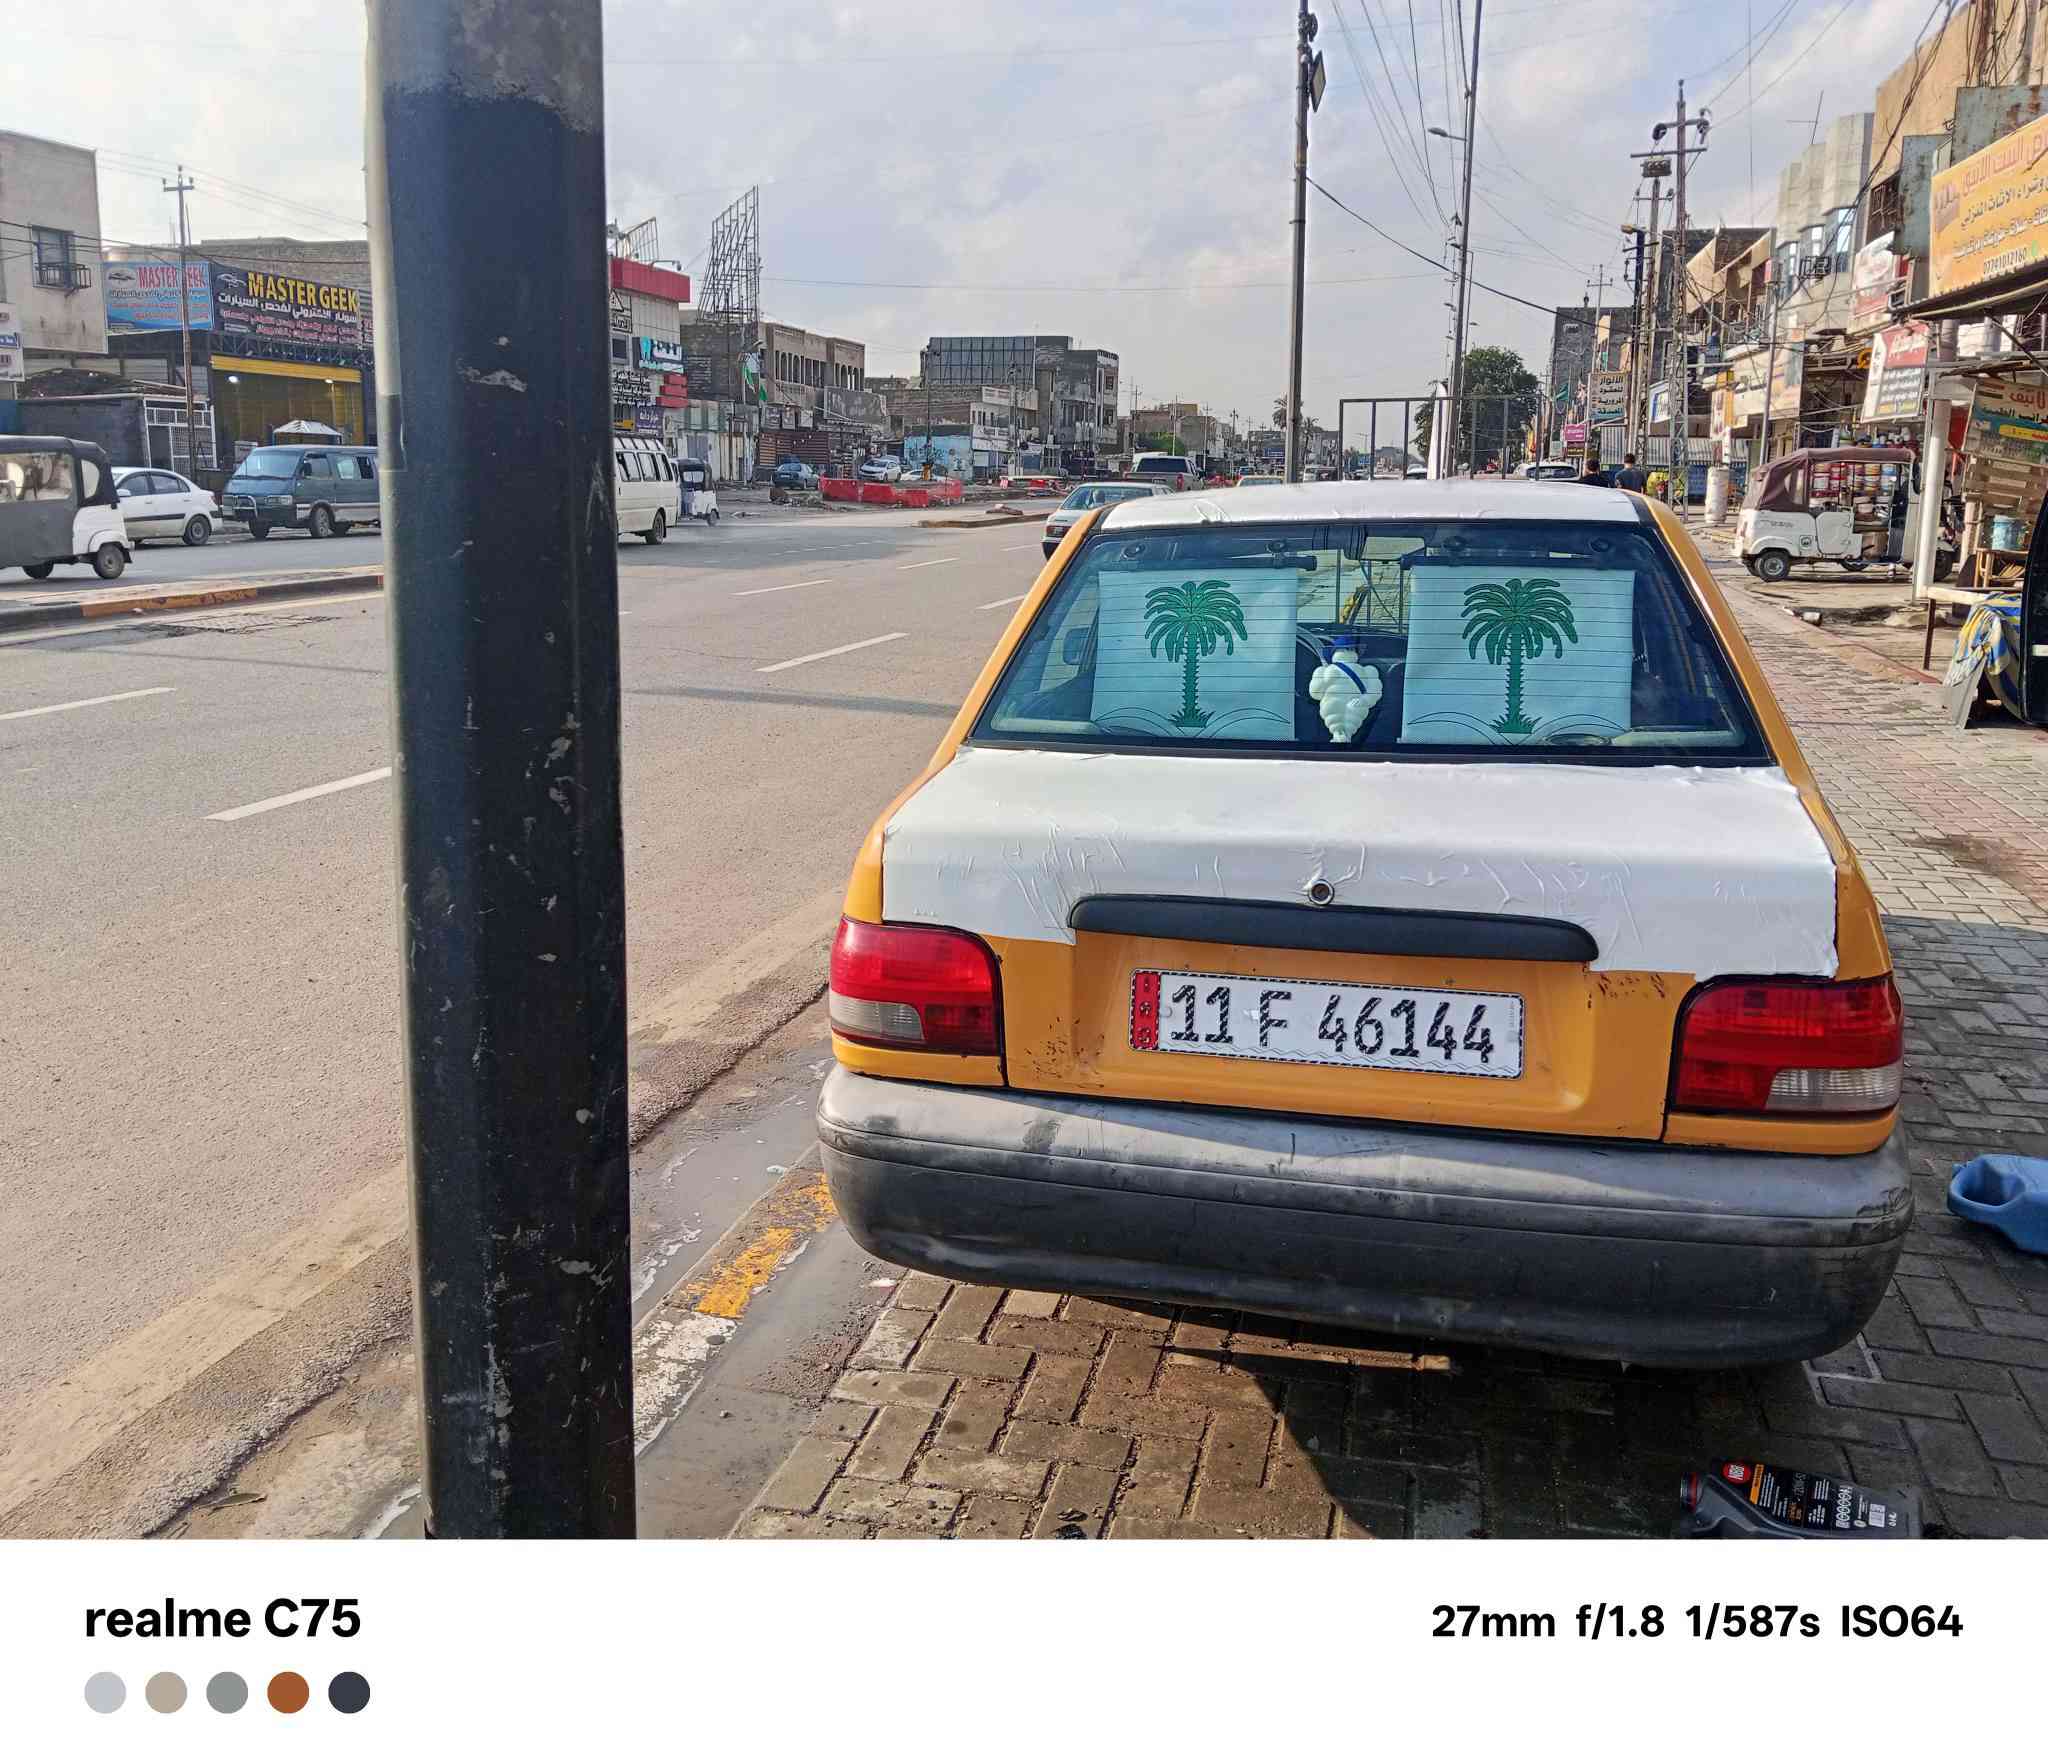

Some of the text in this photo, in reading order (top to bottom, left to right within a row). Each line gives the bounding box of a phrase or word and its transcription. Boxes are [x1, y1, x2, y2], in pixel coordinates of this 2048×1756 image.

[137, 264, 177, 289] MASTER
[248, 271, 358, 312] MASTER GEEK
[218, 292, 258, 308] السيارات
[1171, 984, 1494, 1064] 11 F 46144
